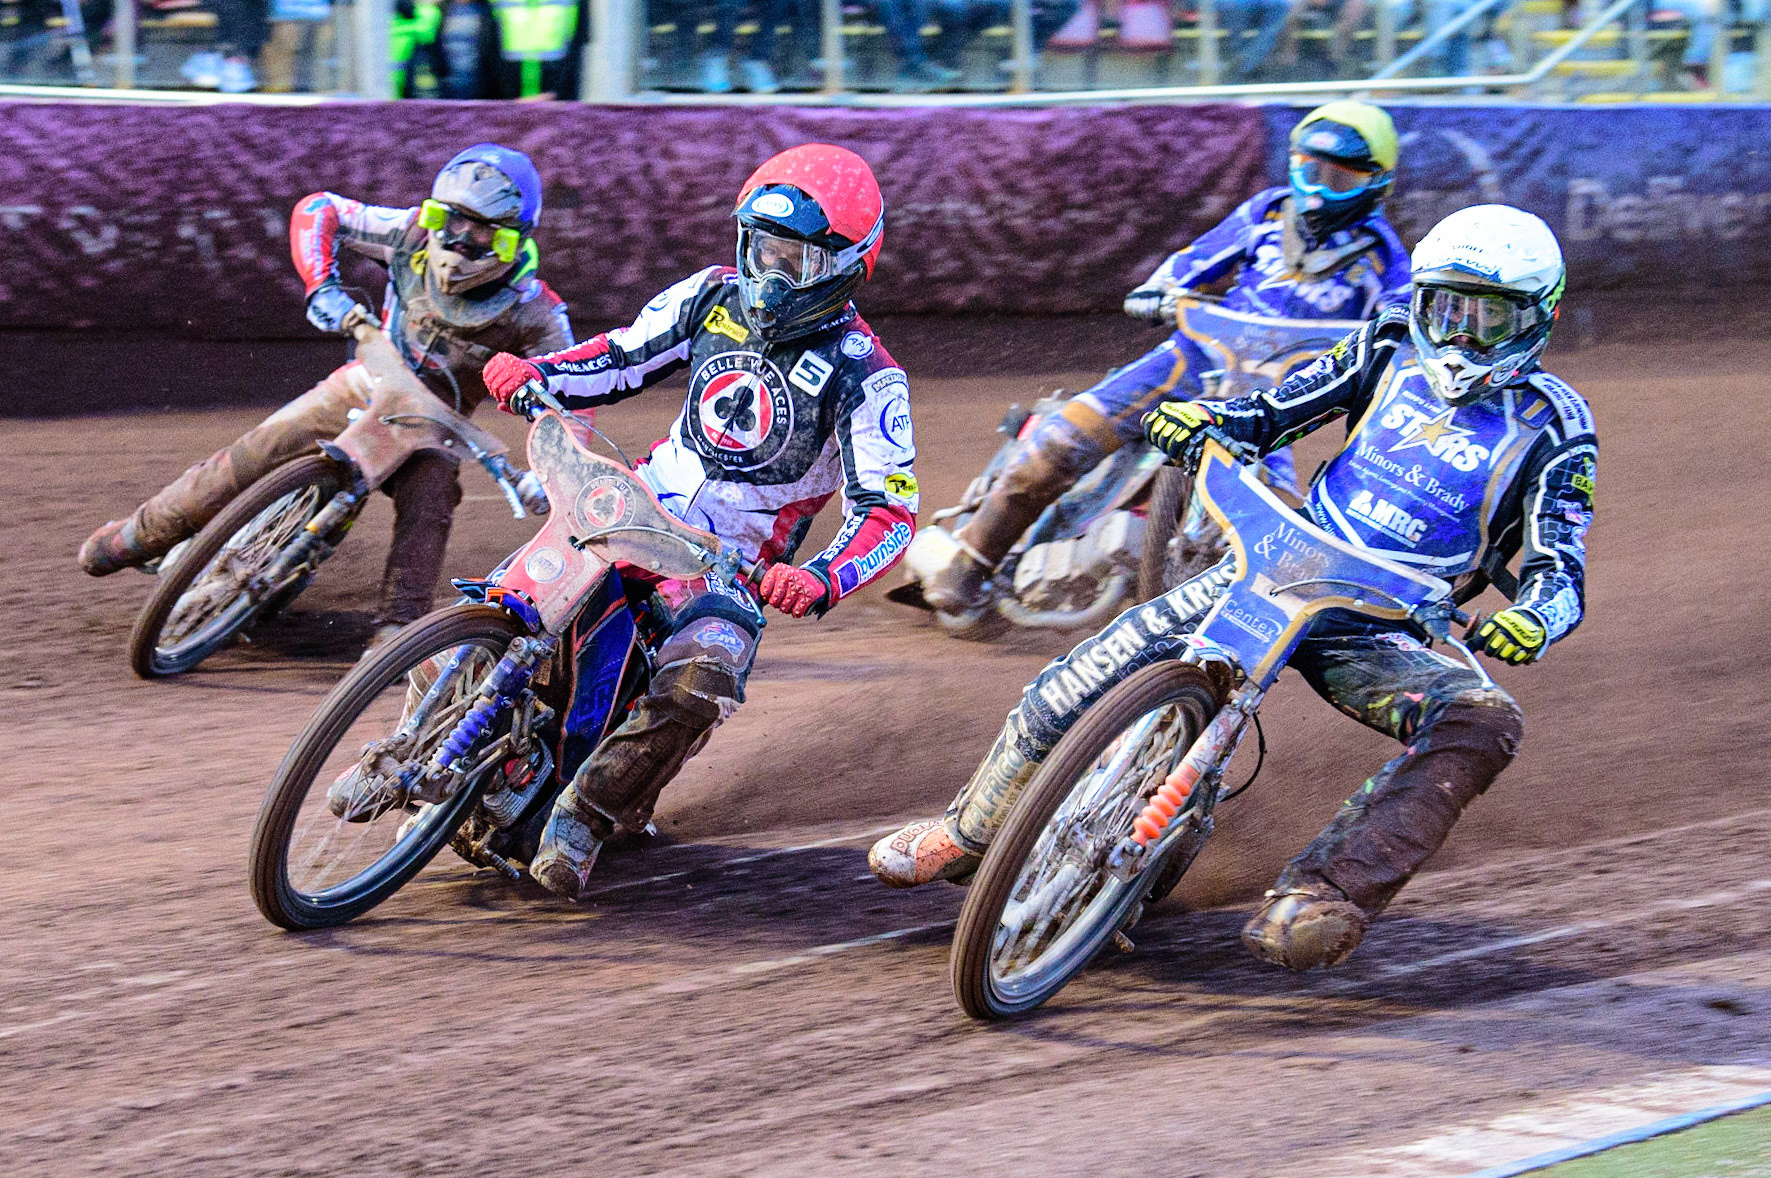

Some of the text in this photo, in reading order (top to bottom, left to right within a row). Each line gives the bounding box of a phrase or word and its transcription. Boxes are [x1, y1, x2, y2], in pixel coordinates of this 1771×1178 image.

[700, 357, 743, 381] BELLE
[771, 387, 788, 424] ACES
[795, 358, 827, 387] 5
[1354, 440, 1406, 477] Minors
[1405, 464, 1427, 487] &
[1423, 477, 1470, 514] Brady
[855, 521, 911, 577] burnside
[1254, 534, 1278, 560] &
[1271, 522, 1331, 567] Minors
[1224, 599, 1276, 638] Centex
[1038, 621, 1147, 717] HANSEN
[1140, 605, 1173, 635] &
